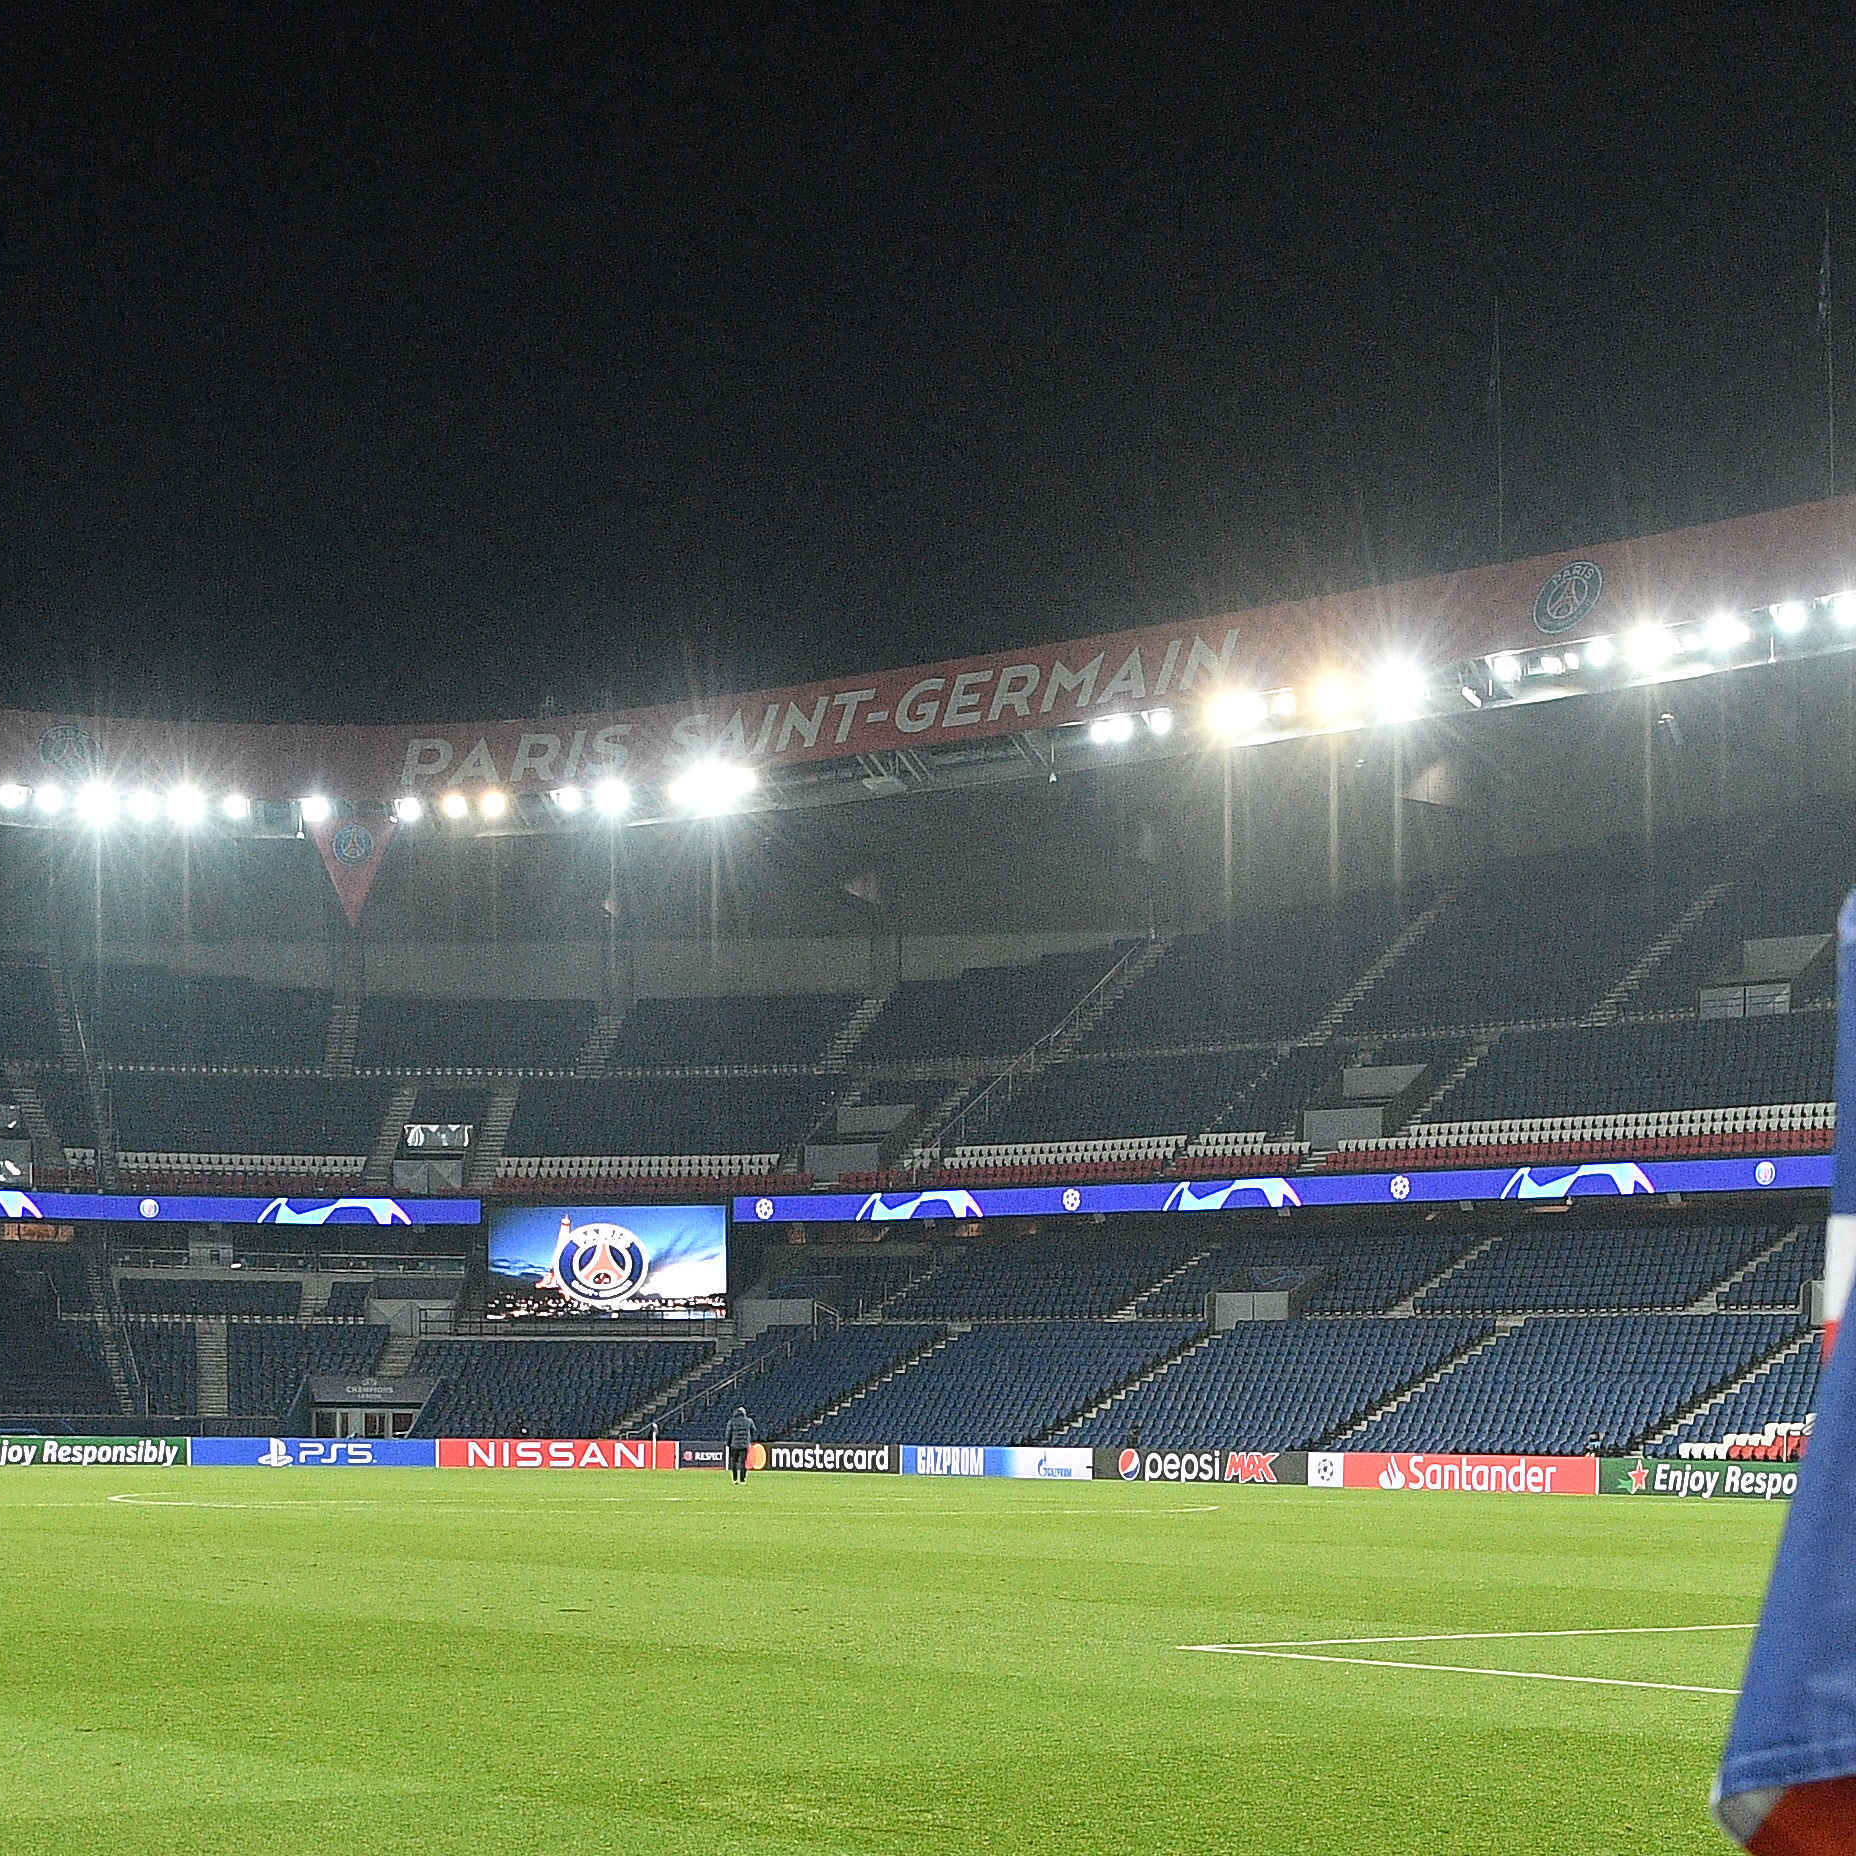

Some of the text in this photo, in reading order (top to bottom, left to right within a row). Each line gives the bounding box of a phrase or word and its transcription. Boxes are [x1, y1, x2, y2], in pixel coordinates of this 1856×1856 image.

[400, 628, 1240, 786] PARIS SAINT-GERMAIN
[42, 1439, 179, 1466] Responsibly
[299, 1442, 373, 1463] PS5
[467, 1441, 645, 1467] NISSAN
[771, 1443, 889, 1471] mastercard
[917, 1446, 985, 1475] GAZPROM
[1144, 1450, 1280, 1484] pepsi MAX
[1408, 1455, 1557, 1493] Santander
[1653, 1463, 1720, 1498] Enjoy
